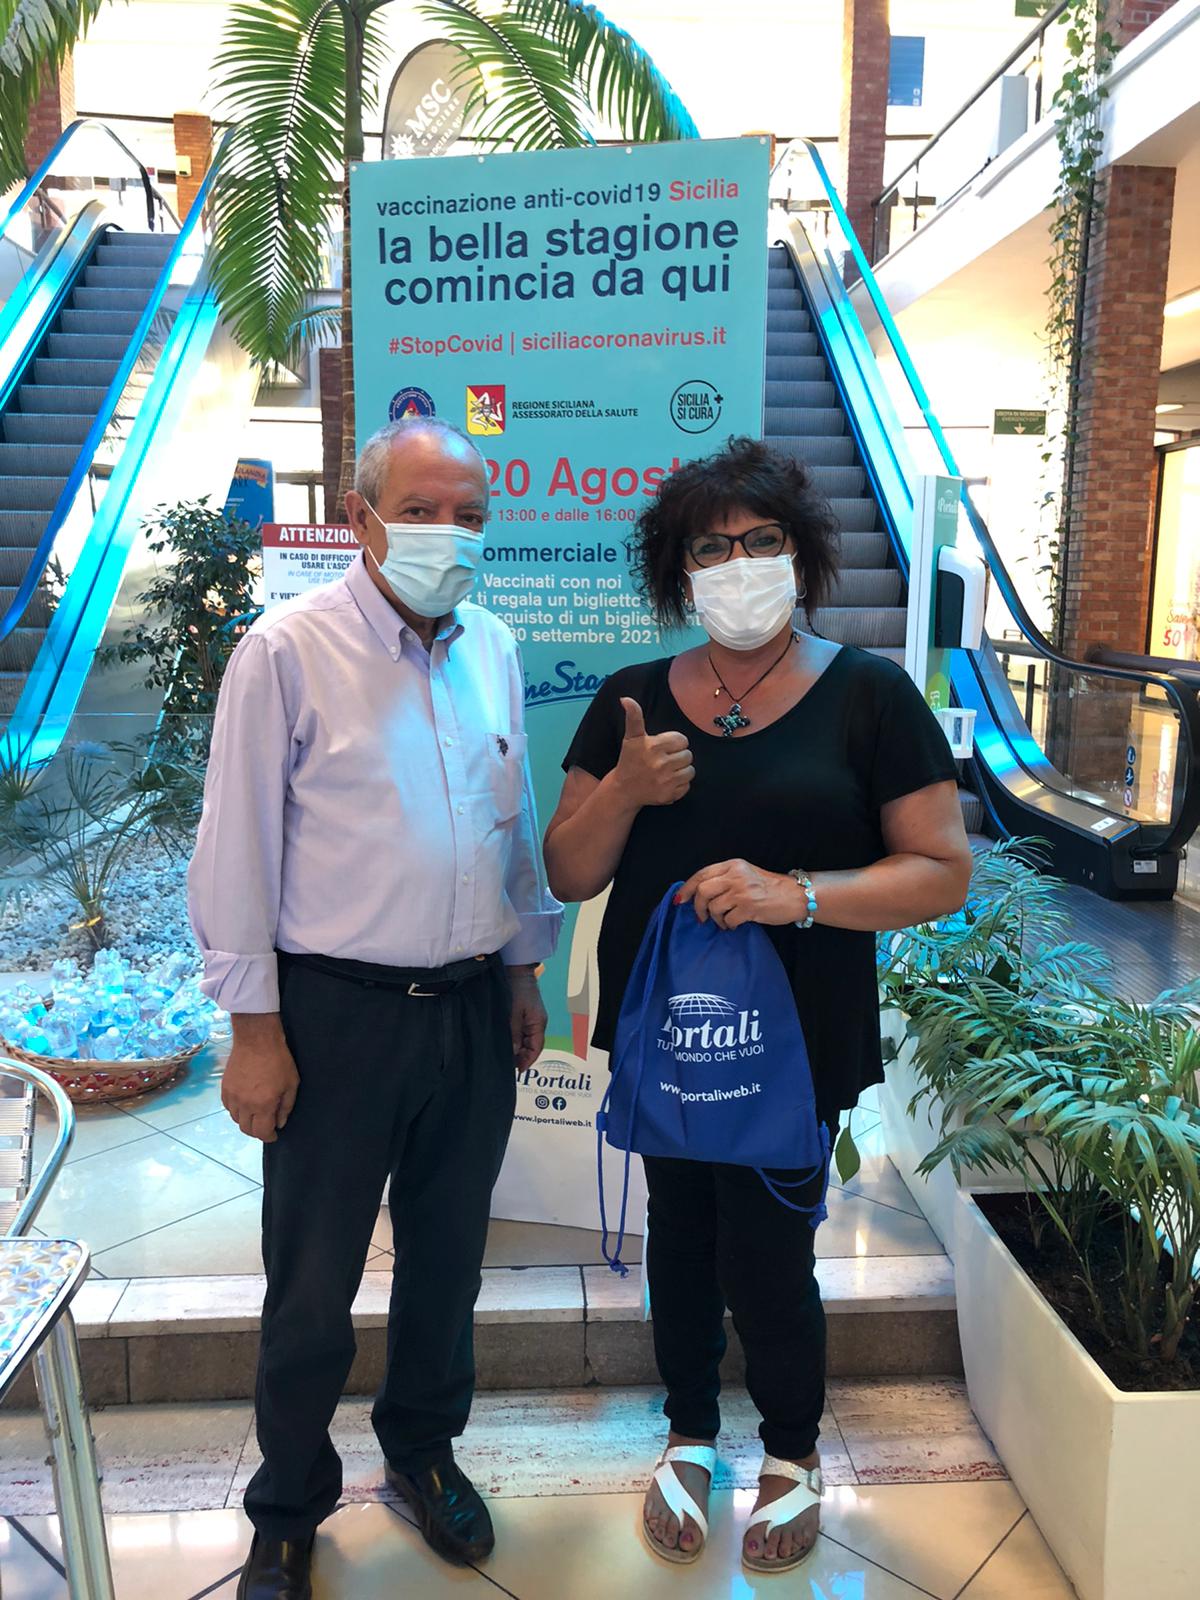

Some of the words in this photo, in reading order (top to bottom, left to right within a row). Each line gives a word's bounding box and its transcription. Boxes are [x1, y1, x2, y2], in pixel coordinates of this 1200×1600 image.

[405, 78, 451, 139] MSC
[377, 193, 516, 216] vaccinazione
[524, 182, 661, 210] anti-covid19
[668, 178, 739, 202] Sicilia
[378, 227, 412, 265] la
[429, 221, 528, 263] bella
[545, 212, 739, 262] stagione
[384, 261, 575, 306] comincia
[592, 258, 644, 298] da
[661, 253, 730, 302] qui
[388, 333, 503, 357] #StopCovid
[522, 326, 727, 352] siciliacoronavirus.it
[511, 401, 550, 411] REGIONE
[552, 399, 596, 410] SICILIANA
[677, 393, 710, 408] SICILIA
[511, 410, 573, 419] ASSESSORATO
[575, 409, 603, 418] DELLA
[604, 408, 639, 418] SALUTE
[677, 407, 687, 420] SI
[689, 406, 715, 421] CURA
[498, 508, 537, 522] 13:00
[541, 511, 549, 522] e
[554, 508, 590, 522] dalle
[596, 508, 636, 522] 16:00
[279, 552, 288, 560] IN
[289, 552, 309, 561] CASO
[310, 553, 319, 561] DI
[482, 542, 618, 563] ommerciale
[301, 561, 325, 570] USARE
[483, 573, 555, 589] Vaccinati
[560, 576, 591, 589] con
[596, 574, 622, 589] noi
[477, 591, 488, 606] ti
[492, 592, 543, 609] regala
[547, 594, 568, 607] un
[558, 609, 574, 625] di
[579, 613, 600, 625] un
[532, 626, 616, 643] settembre
[621, 629, 661, 644] 2021
[714, 1050, 737, 1062] CHE
[738, 1043, 764, 1057] VUOI
